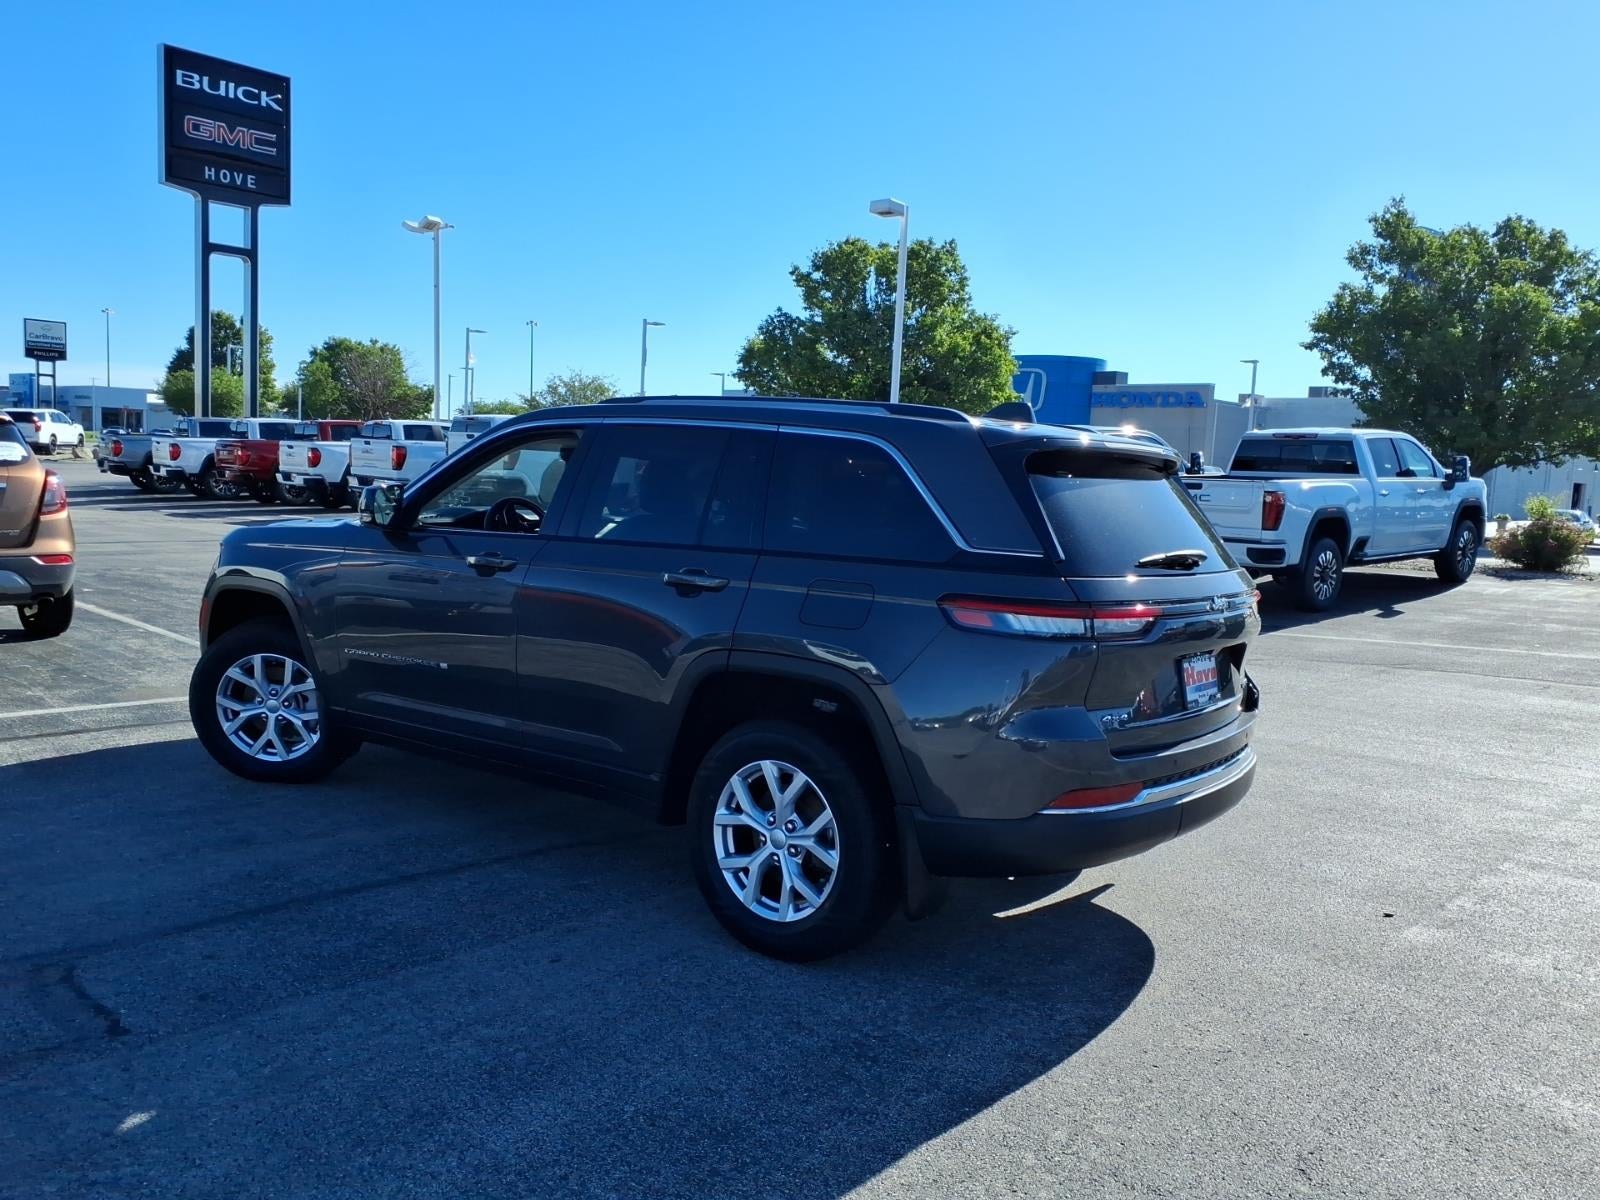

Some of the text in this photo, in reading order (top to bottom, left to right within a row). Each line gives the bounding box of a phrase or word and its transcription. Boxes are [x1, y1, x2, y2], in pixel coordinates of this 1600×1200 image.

[175, 69, 283, 112] BUICK
[184, 115, 277, 155] GMC
[204, 166, 257, 188] HOVE
[1091, 391, 1207, 408] HONDA
[1192, 494, 1211, 502] MC
